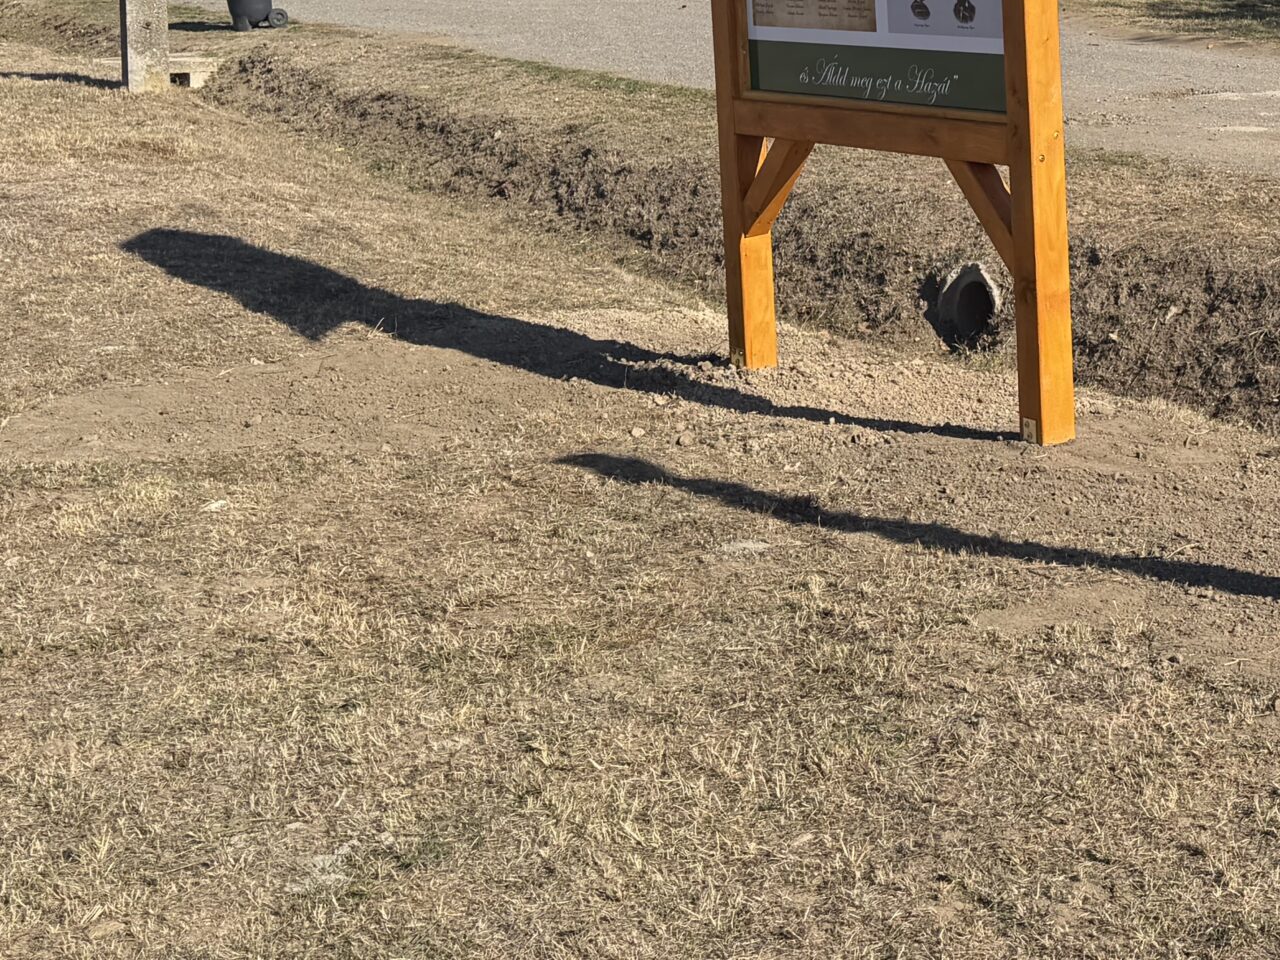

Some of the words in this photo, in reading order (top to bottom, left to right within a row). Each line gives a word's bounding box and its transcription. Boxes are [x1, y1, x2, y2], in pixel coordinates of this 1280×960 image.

[799, 67, 809, 84] és
[811, 54, 849, 85] Áldd
[850, 76, 873, 99] meg
[876, 74, 892, 99] ezt
[894, 80, 902, 91] a
